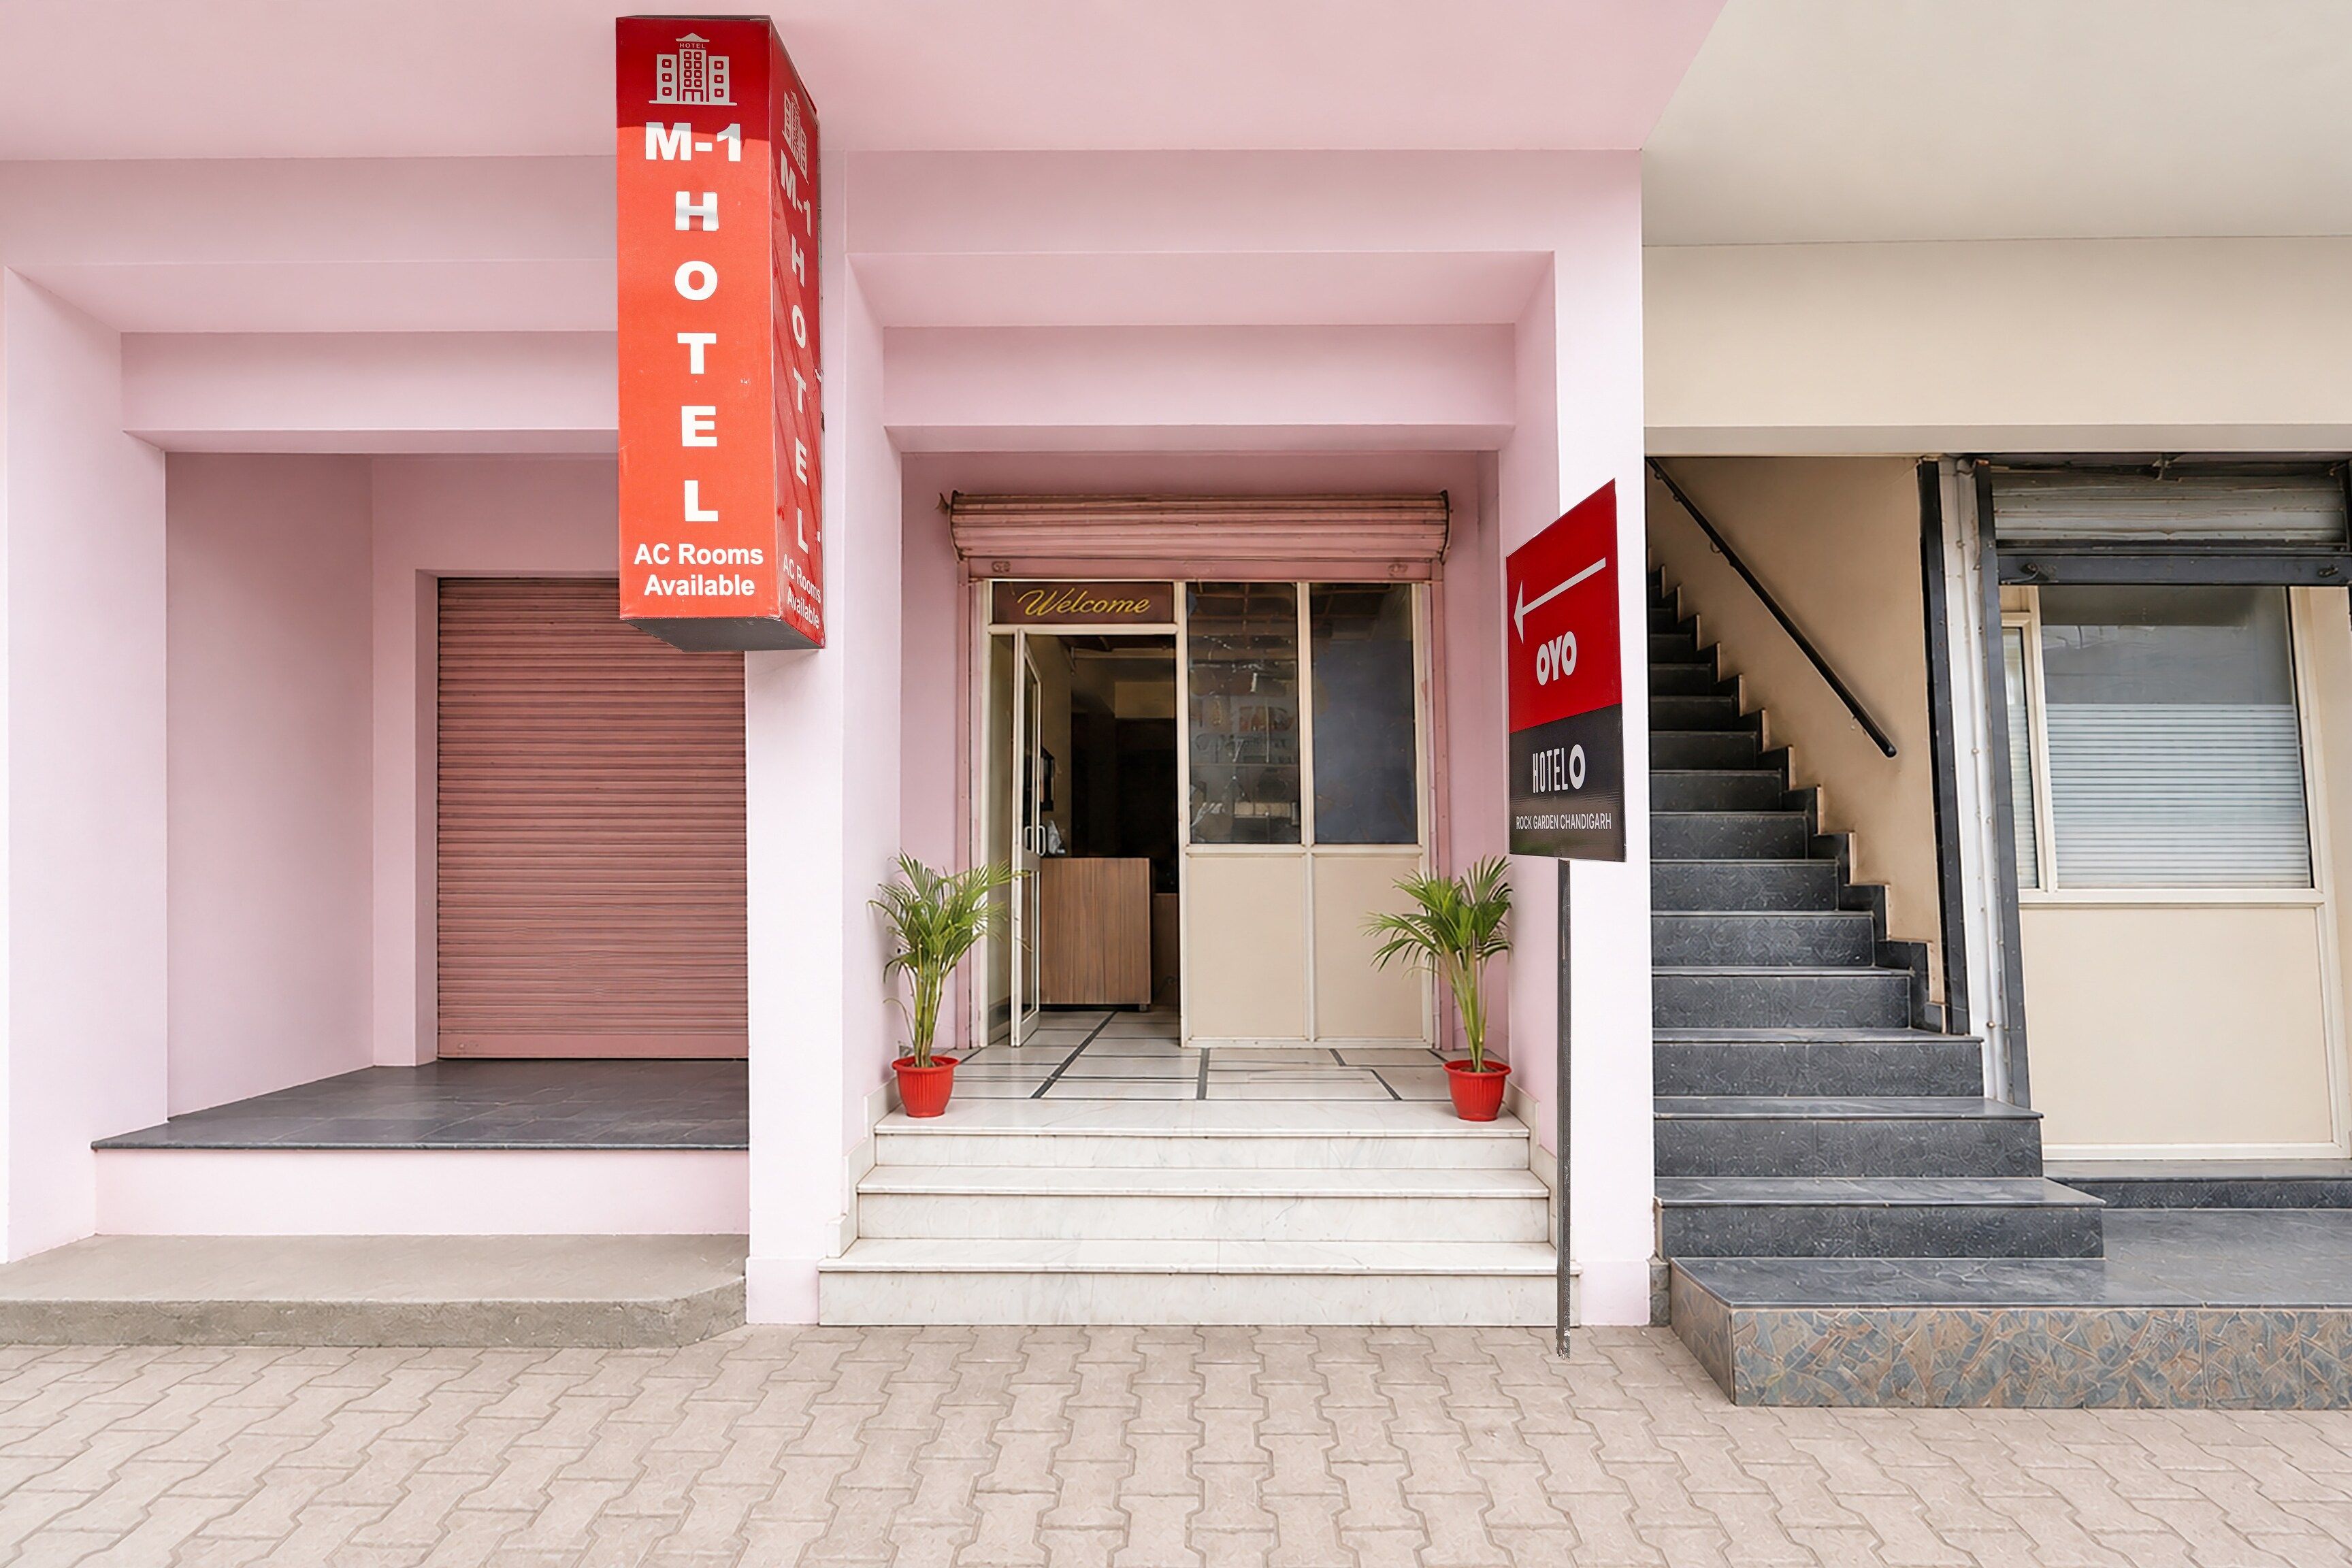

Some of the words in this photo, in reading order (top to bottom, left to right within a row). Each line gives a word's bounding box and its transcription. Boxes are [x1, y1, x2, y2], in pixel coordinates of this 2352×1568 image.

[645, 122, 740, 162] M-1
[781, 149, 811, 238] M-1
[675, 191, 719, 521] HOTEL
[791, 233, 808, 554] HOTEL
[634, 543, 670, 565] AC
[678, 544, 764, 566] Rooms
[644, 574, 755, 597] Available
[783, 553, 795, 580] AC
[796, 565, 821, 604] Rooms
[787, 586, 819, 630] Available
[1017, 588, 1150, 617] Welcome
[1536, 631, 1577, 686] OYO
[1516, 814, 1532, 830] ROCK
[1533, 813, 1558, 830] GARDEN
[1560, 812, 1612, 830] CHANDIGARH
